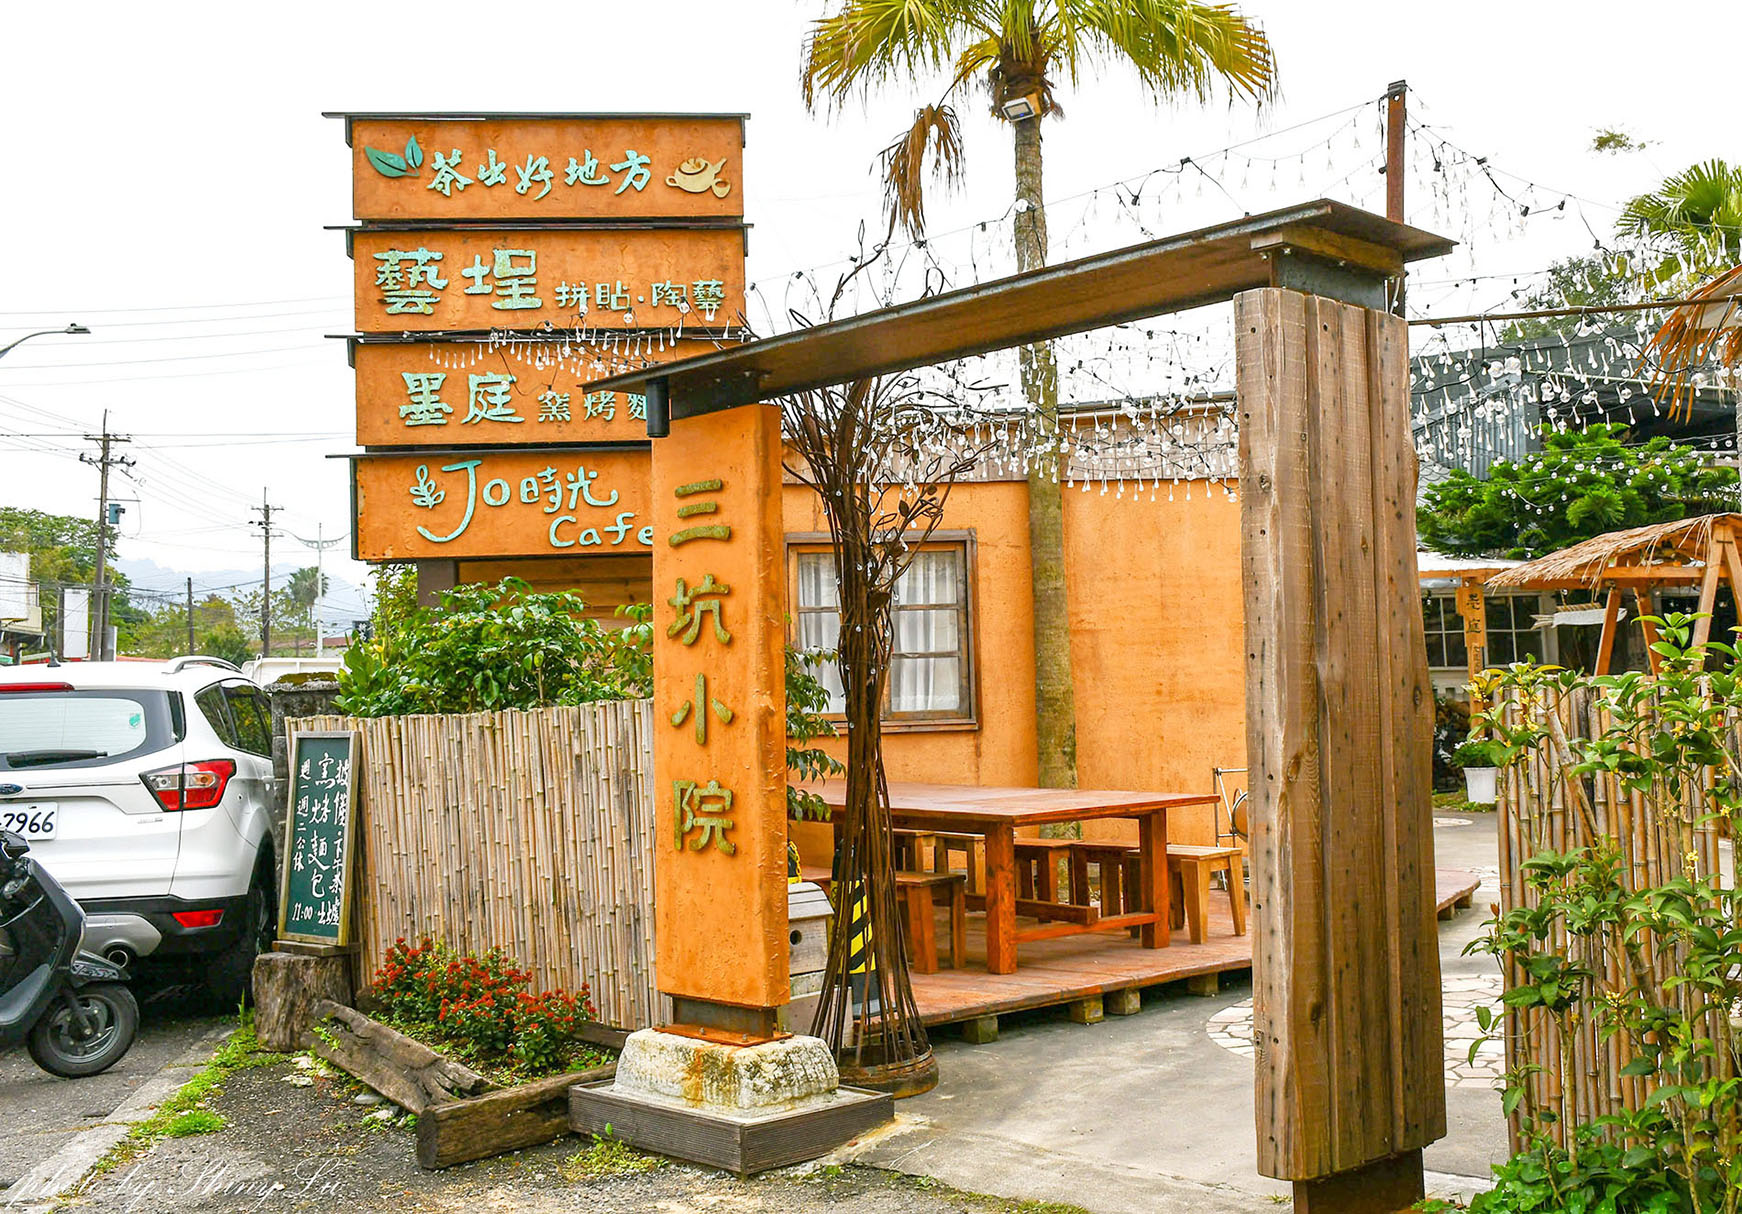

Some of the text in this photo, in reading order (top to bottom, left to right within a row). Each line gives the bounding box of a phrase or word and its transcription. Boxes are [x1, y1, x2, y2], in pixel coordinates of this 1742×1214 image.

[427, 149, 651, 200] 茶出好地方
[399, 371, 525, 425] 墨庭
[549, 511, 653, 547] Cafe
[667, 479, 735, 856] 三坑小院
[291, 902, 314, 922] 11:00
